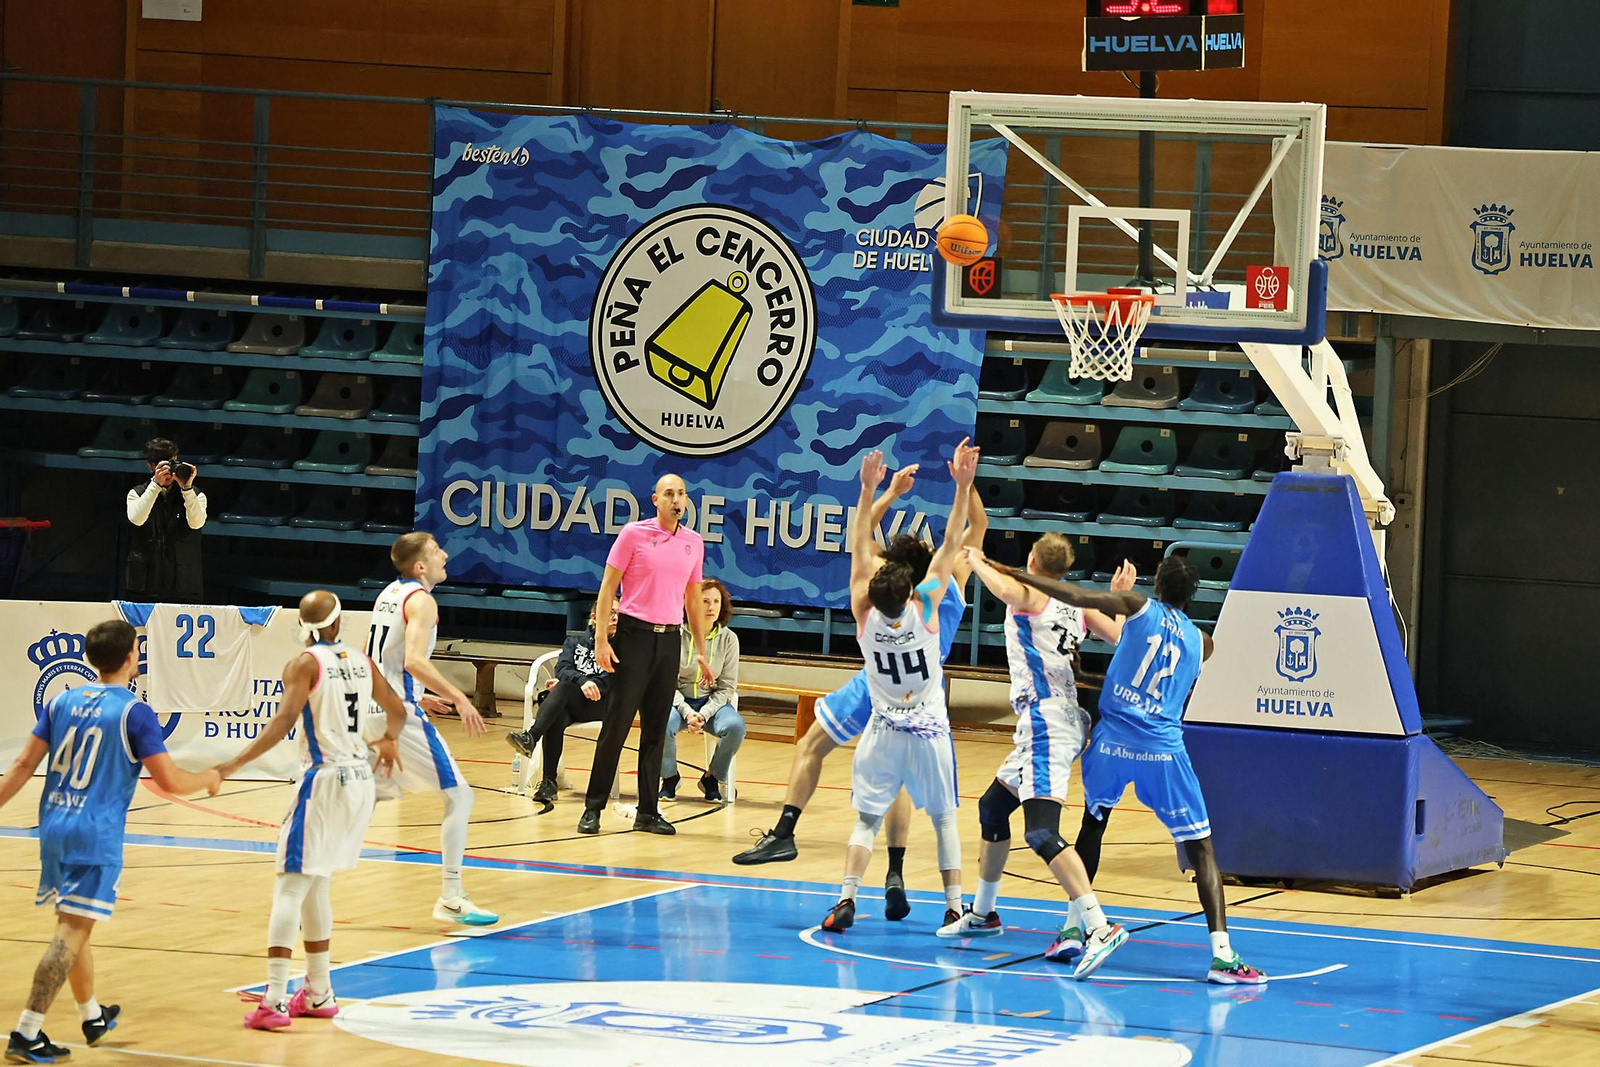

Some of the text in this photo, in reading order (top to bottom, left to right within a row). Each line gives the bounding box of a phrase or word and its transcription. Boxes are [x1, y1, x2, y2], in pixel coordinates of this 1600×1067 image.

[1090, 35, 1198, 53] HUELVA
[1205, 32, 1242, 51] HUELVA
[462, 142, 511, 165] besten
[855, 228, 929, 249] CIUDAD
[1349, 231, 1421, 244] Ayuntamiento de
[1519, 240, 1580, 252] Ayuntamiento
[1581, 241, 1592, 251] de
[950, 242, 982, 256] Wilson
[1349, 243, 1423, 262] HUELVA
[853, 250, 878, 269] DE
[1519, 252, 1594, 269] HUELVA
[606, 226, 796, 387] PEÑA EL CENCERRO
[661, 412, 725, 430] HUELVA
[441, 479, 640, 535] CIUDAD
[175, 613, 216, 659] 22
[873, 648, 930, 685] 44
[1131, 633, 1181, 701] 12
[1257, 685, 1335, 698] Ayuntamiento de
[344, 692, 358, 733] 3
[1256, 698, 1334, 717] HUELVA
[50, 725, 103, 790] 40
